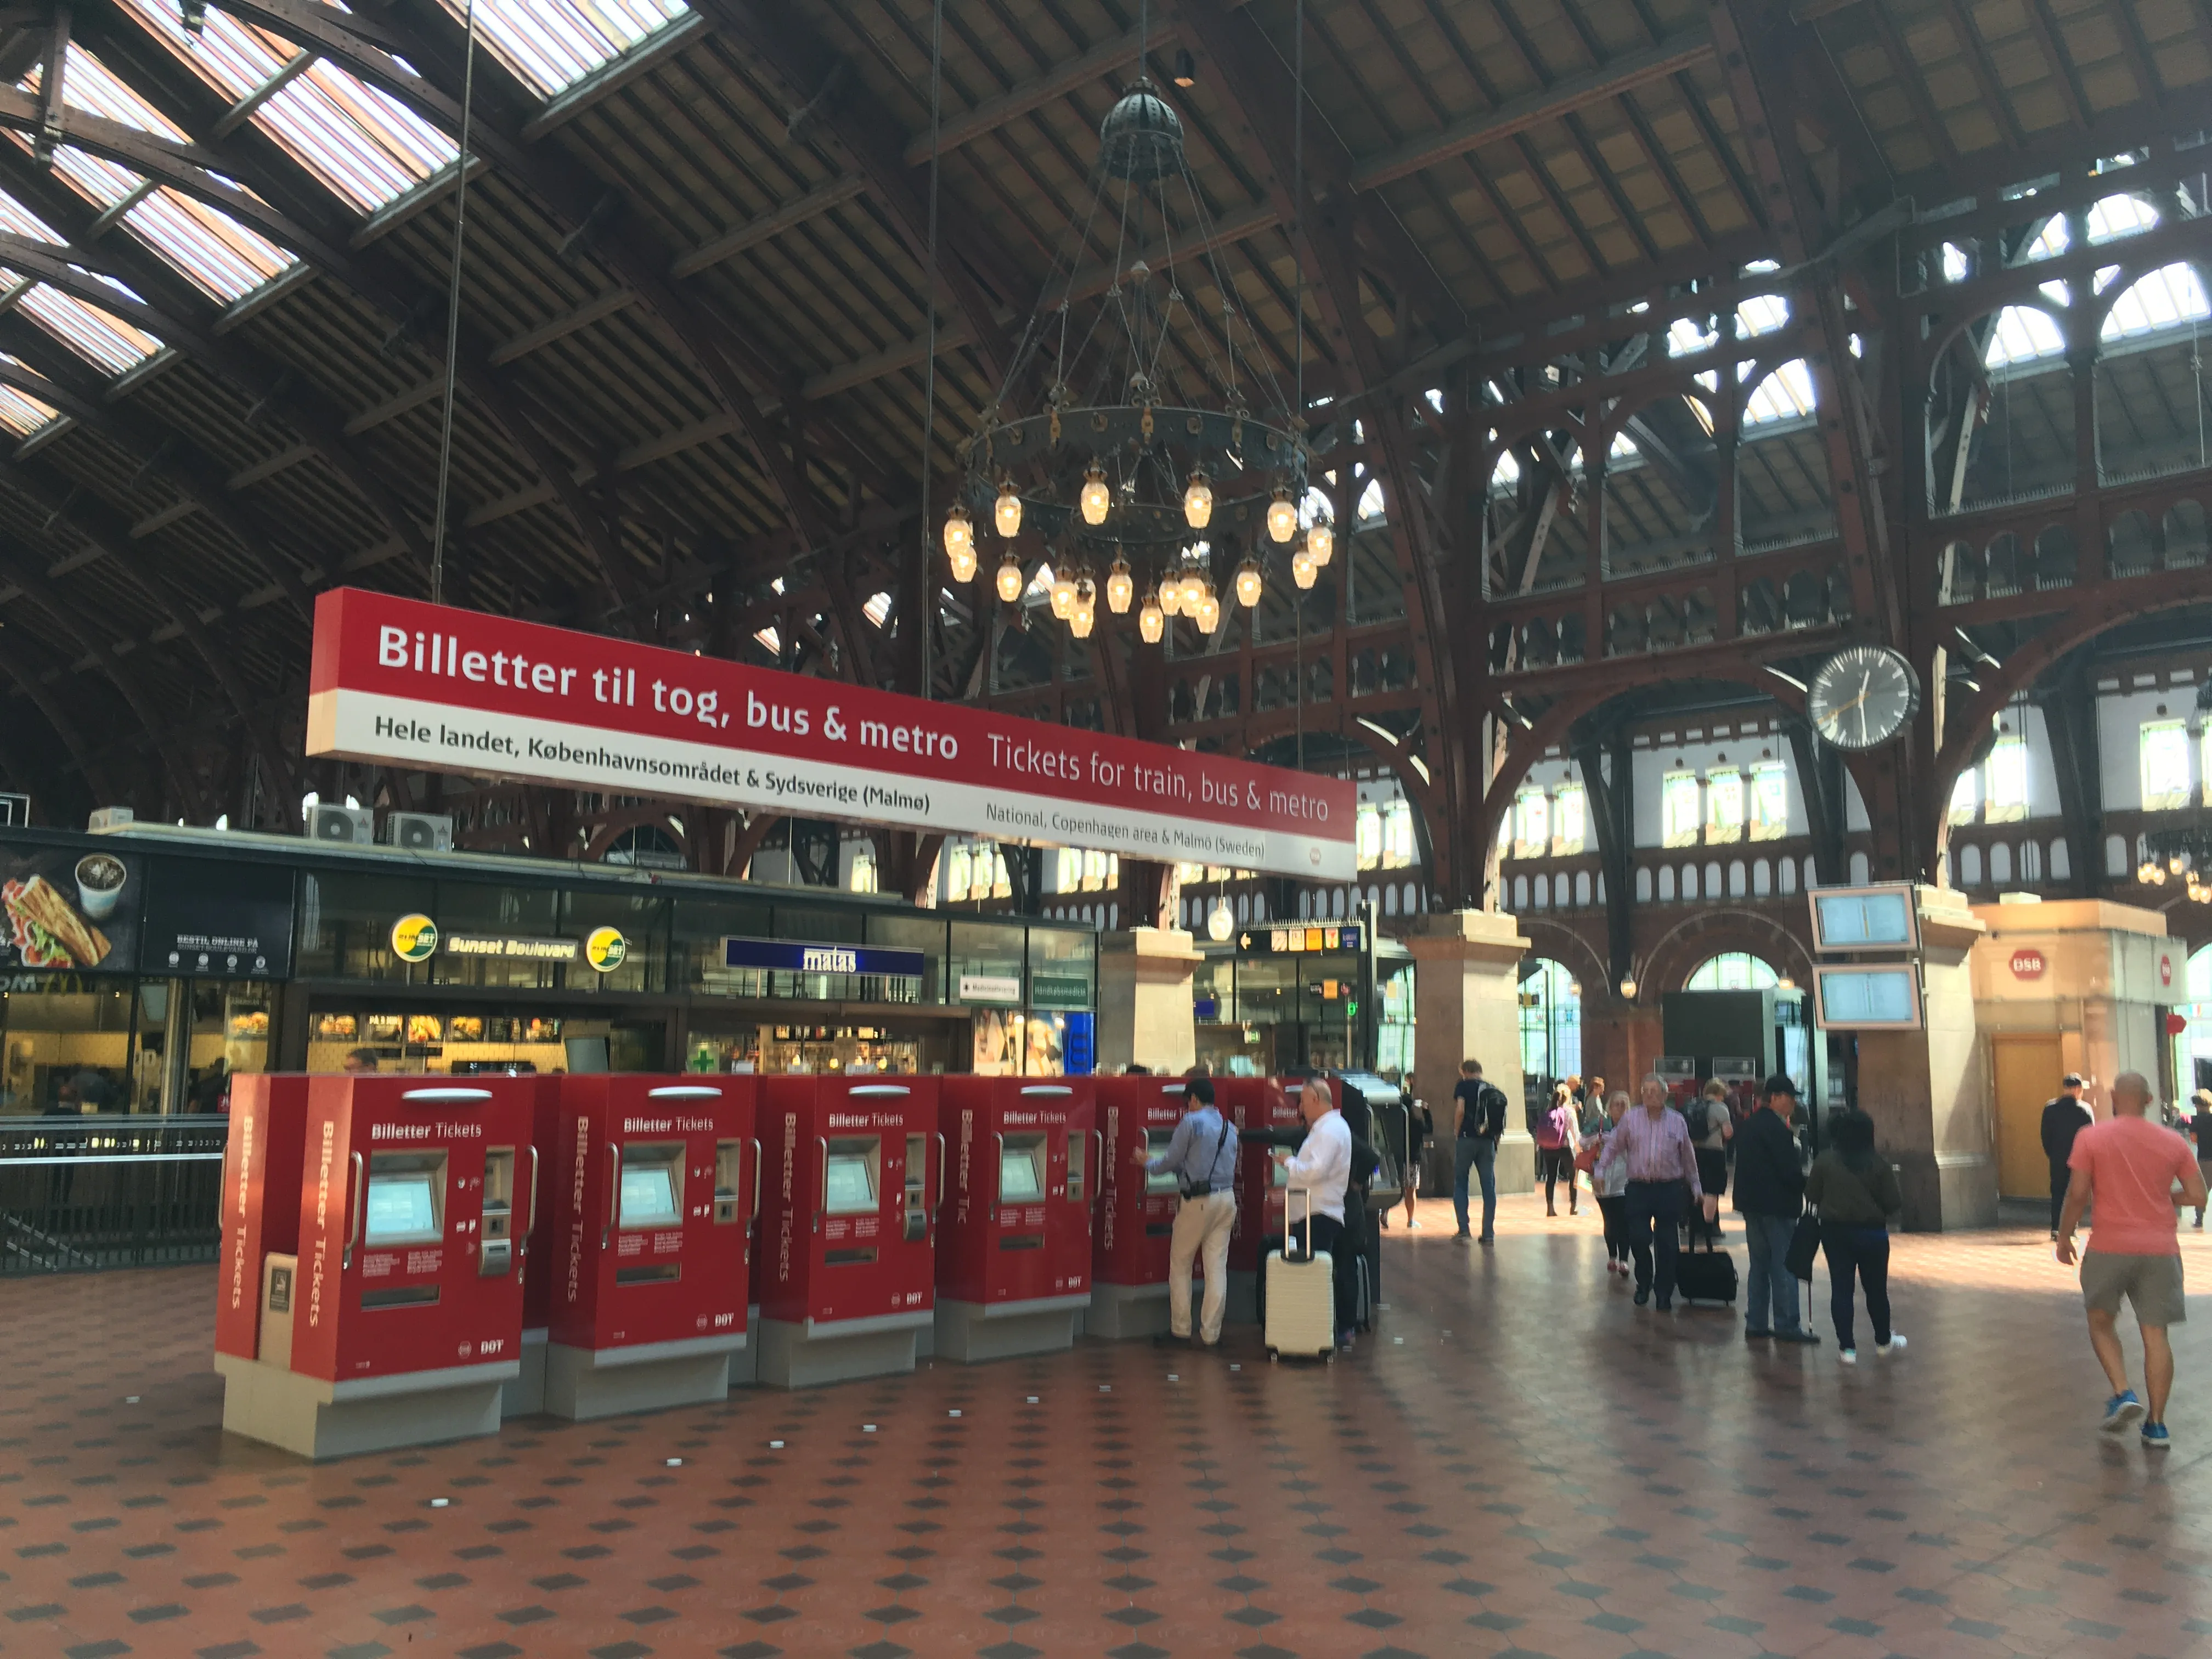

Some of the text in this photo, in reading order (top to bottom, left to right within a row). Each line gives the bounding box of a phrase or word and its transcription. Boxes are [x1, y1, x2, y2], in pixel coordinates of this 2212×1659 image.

[379, 625, 958, 760] Billetter til tog, bus & metro
[375, 715, 930, 815] Hele landet, Københavnsområdet & Sydsverige (Malmø)
[988, 732, 1328, 822] Tickets for train, bus & metro
[987, 802, 1265, 860] National, Copenhagen area & Malmö (Sweden)
[212, 936, 245, 947] ONLINE
[448, 937, 575, 958] Sunset Boulevard
[803, 946, 856, 973] matas
[2013, 957, 2041, 972] DSB
[624, 1115, 714, 1133] Billetter Tickets
[830, 1112, 904, 1128] Billetter Tickets
[1004, 1110, 1066, 1125] Billetter Tickets
[1148, 1107, 1177, 1120] Billetter
[1272, 1106, 1298, 1119] Billetter
[372, 1121, 482, 1140] Billetter Tickets
[568, 1116, 589, 1302] Billetter Tickets
[780, 1113, 796, 1283] Billetter Tickets
[232, 1115, 253, 1309] Billetter Tickets
[309, 1120, 334, 1328] Billetter Tickets
